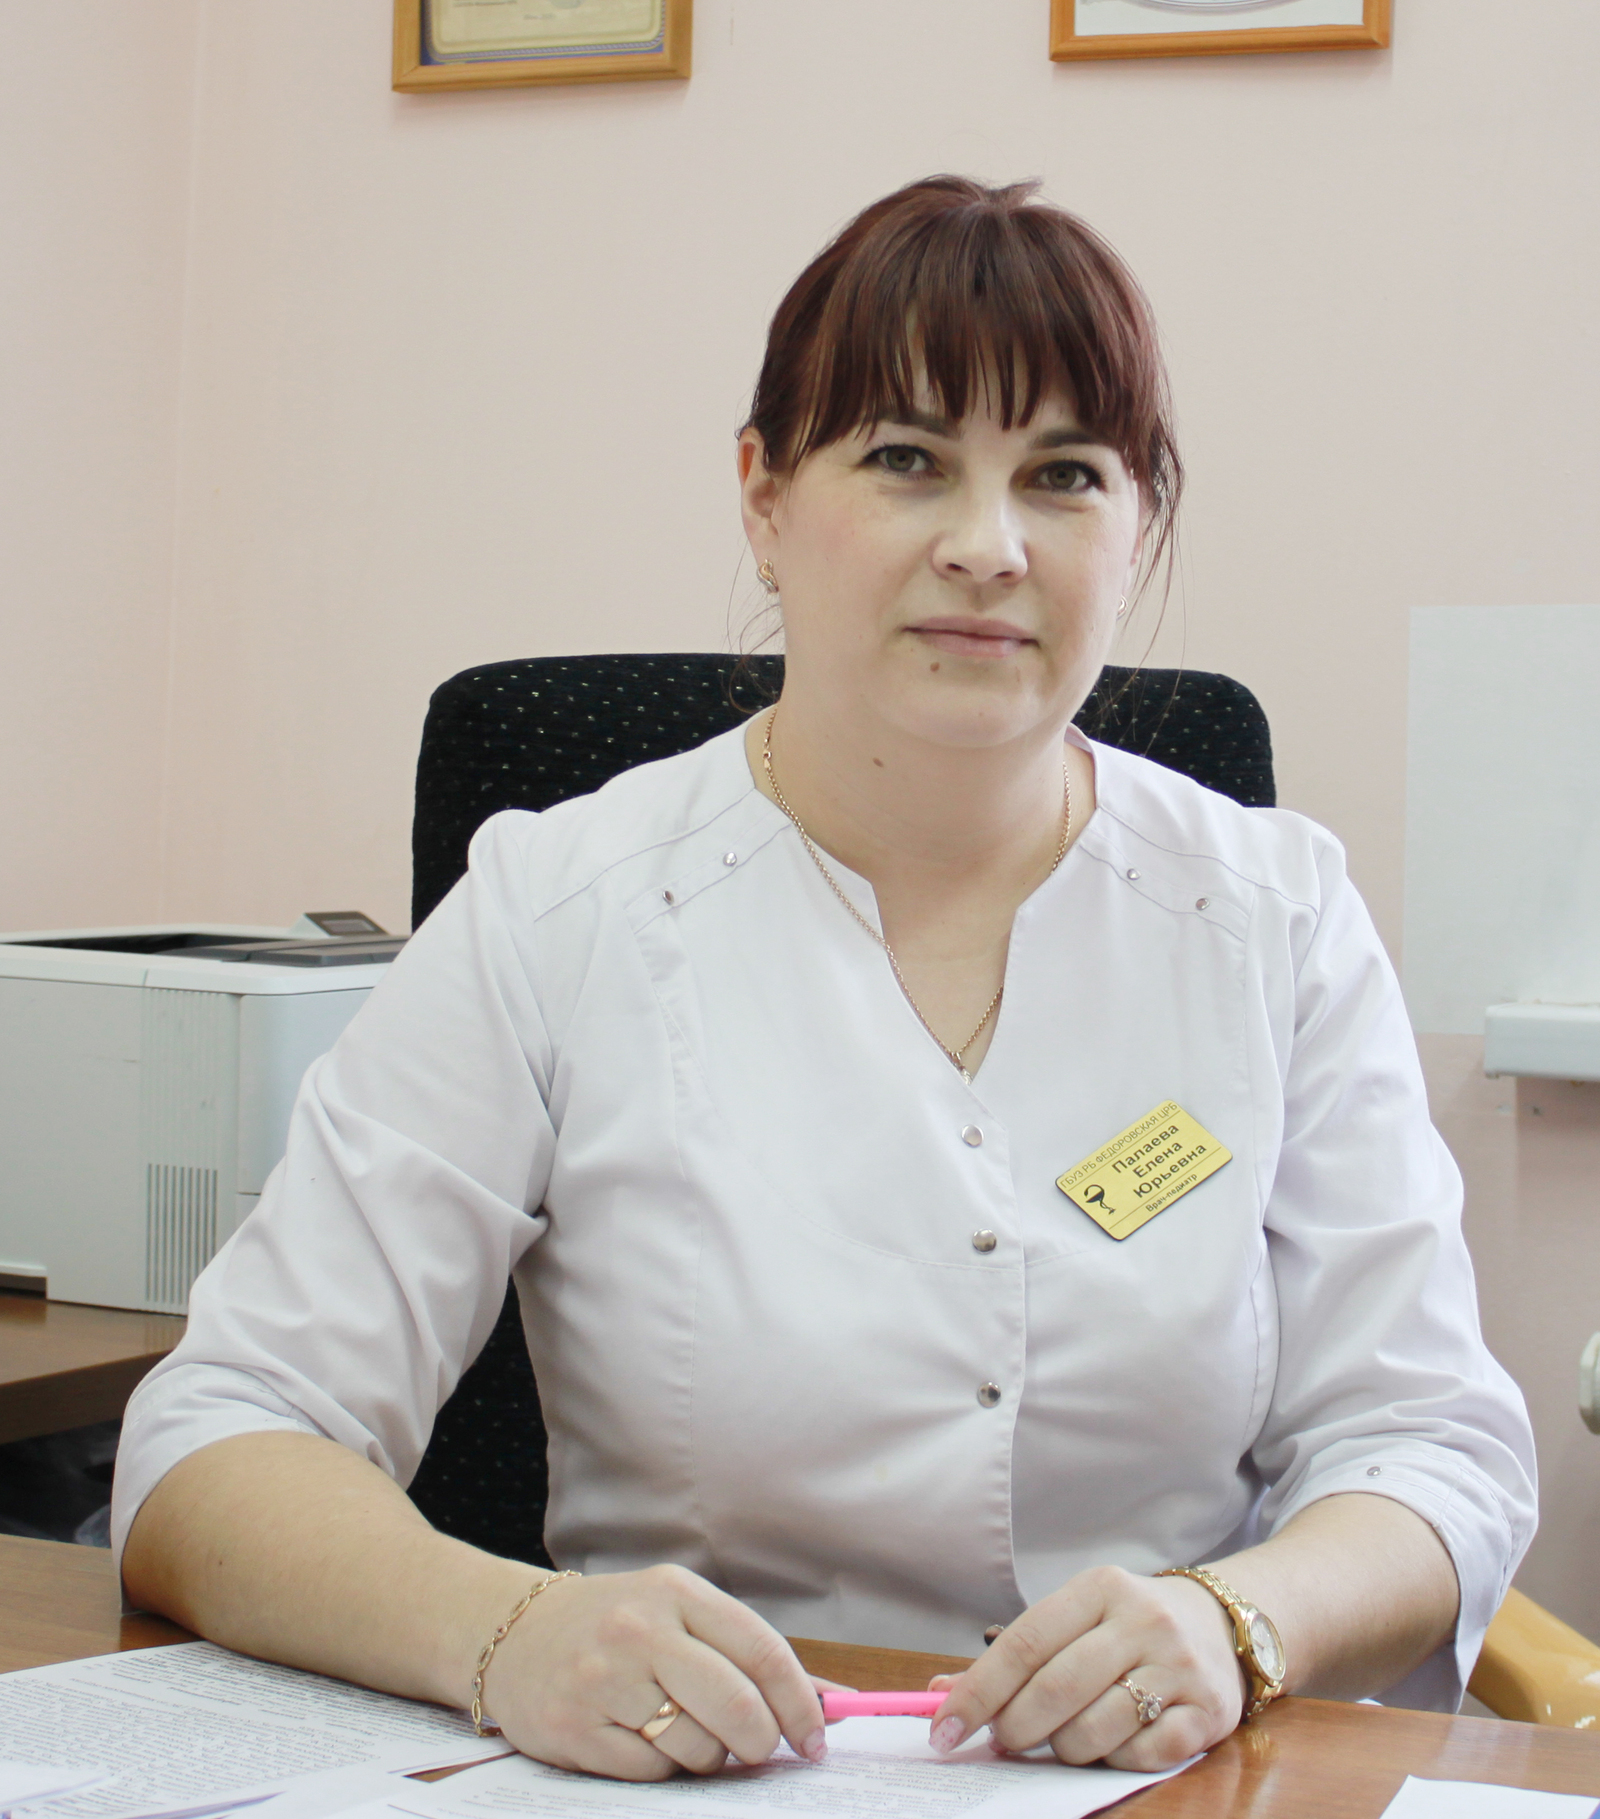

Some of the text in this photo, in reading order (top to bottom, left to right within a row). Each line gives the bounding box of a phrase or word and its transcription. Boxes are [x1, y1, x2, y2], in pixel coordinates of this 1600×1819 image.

[1082, 1161, 1097, 1173] РБ
[1157, 1102, 1178, 1118] ЦРБ
[1111, 1125, 1179, 1173] Палаева
[1132, 1142, 1183, 1178] Елена
[1133, 1145, 1207, 1198] Юрьевна
[1145, 1173, 1198, 1212] Врач-педиатр
